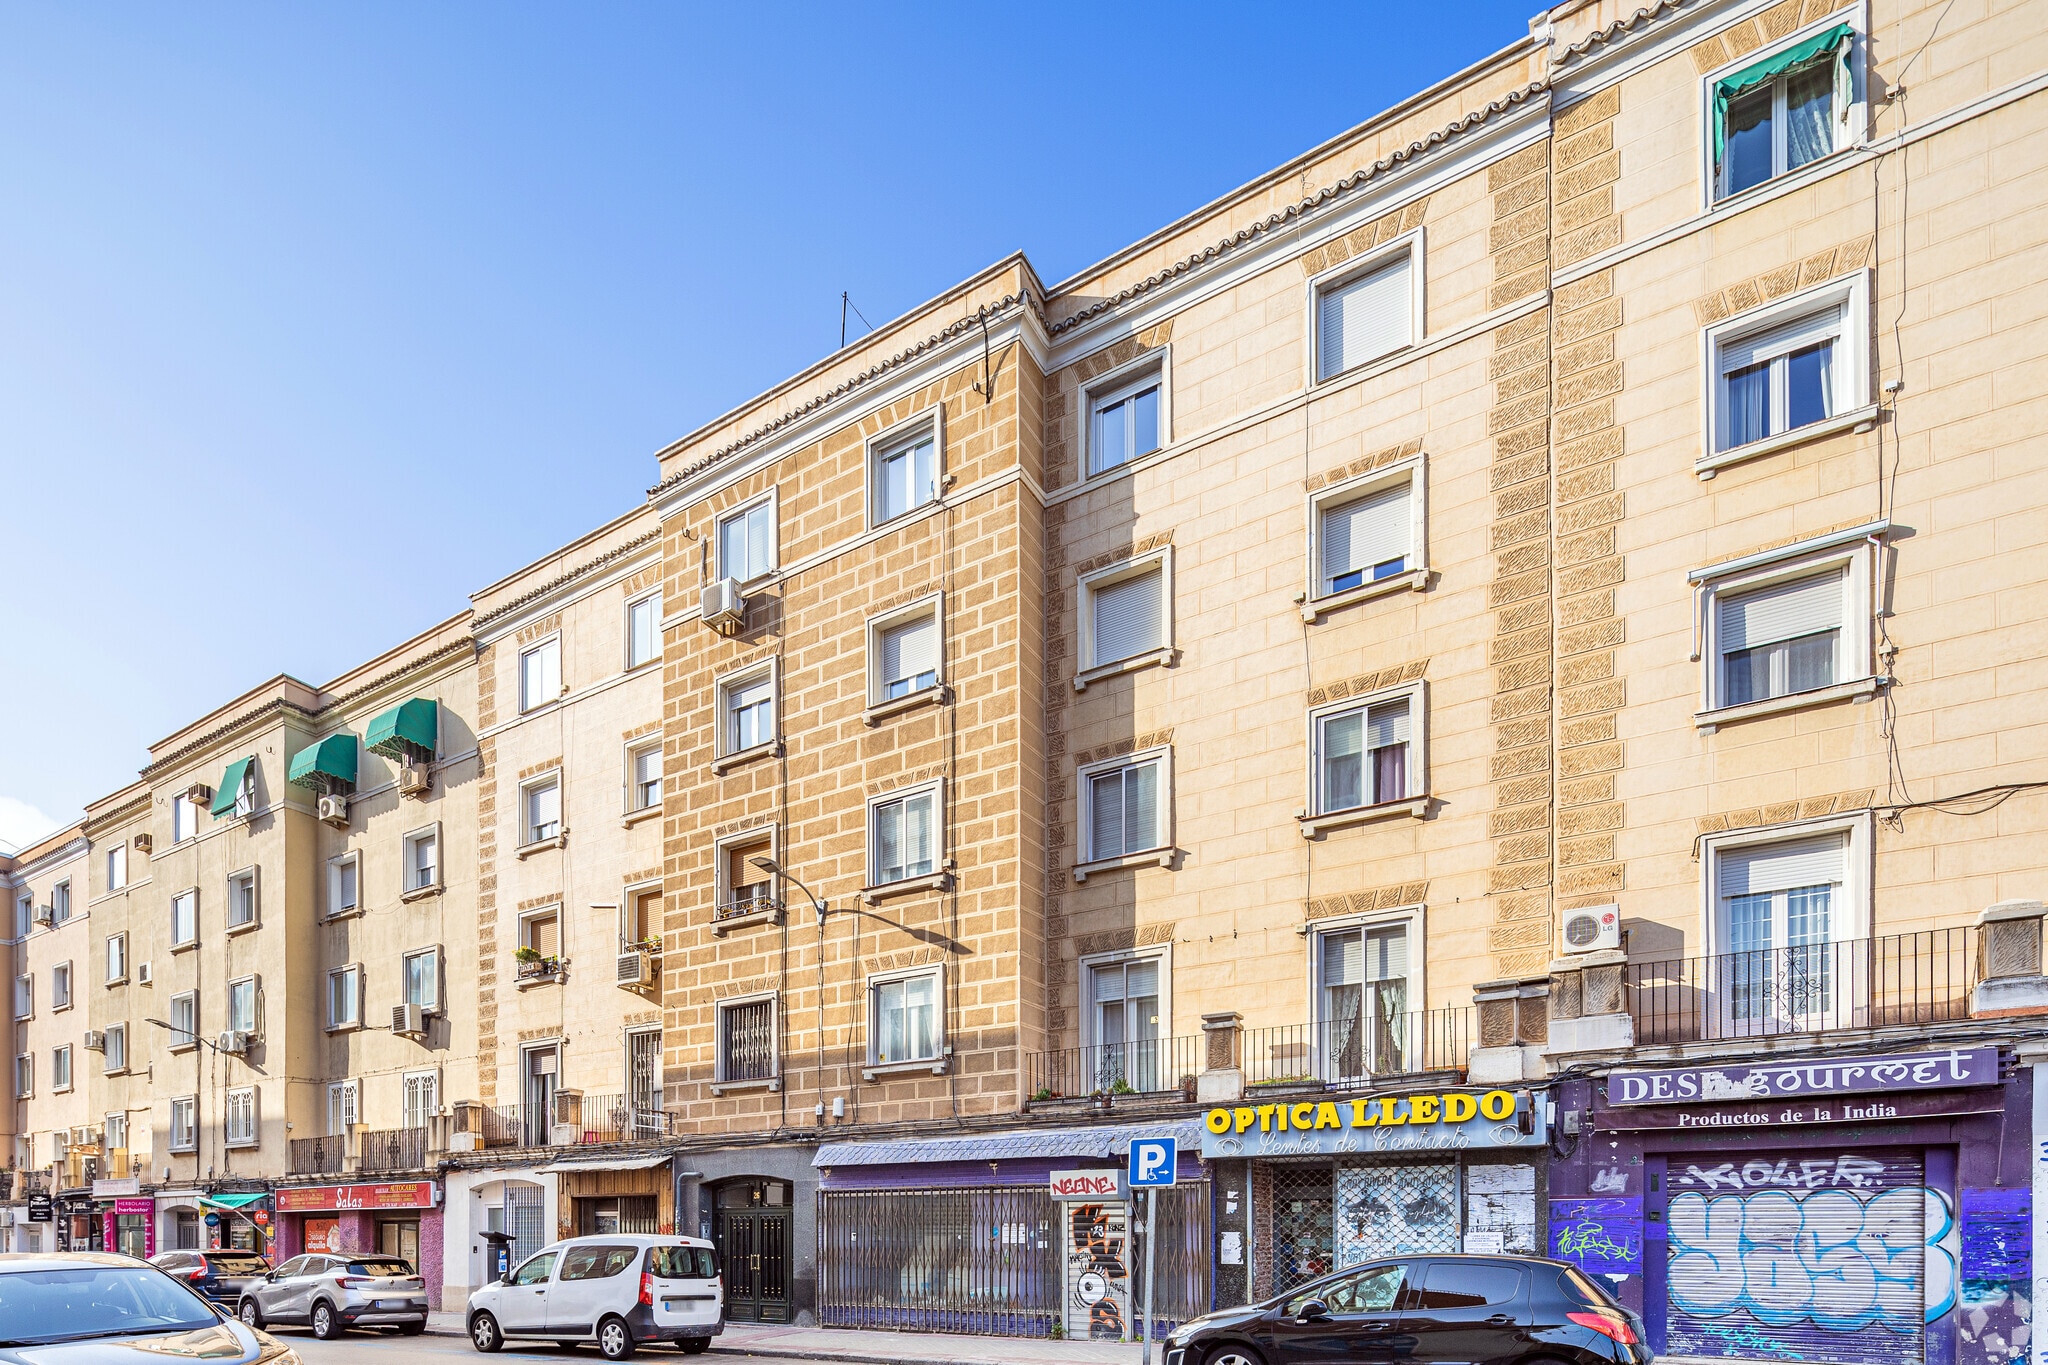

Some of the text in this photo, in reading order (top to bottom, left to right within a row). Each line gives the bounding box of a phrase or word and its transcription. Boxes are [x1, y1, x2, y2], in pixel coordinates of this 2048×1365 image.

[1620, 1072, 1706, 1101] DES
[1206, 1090, 1516, 1134] OPTICA LLEDO
[1678, 1104, 1898, 1127] Productos de la India
[1257, 1126, 1471, 1156] Lentes de Contacto
[1138, 1144, 1166, 1181] P
[336, 1187, 362, 1208] Salas
[390, 1184, 417, 1192] AUTOCARES
[256, 1211, 268, 1219] ria
